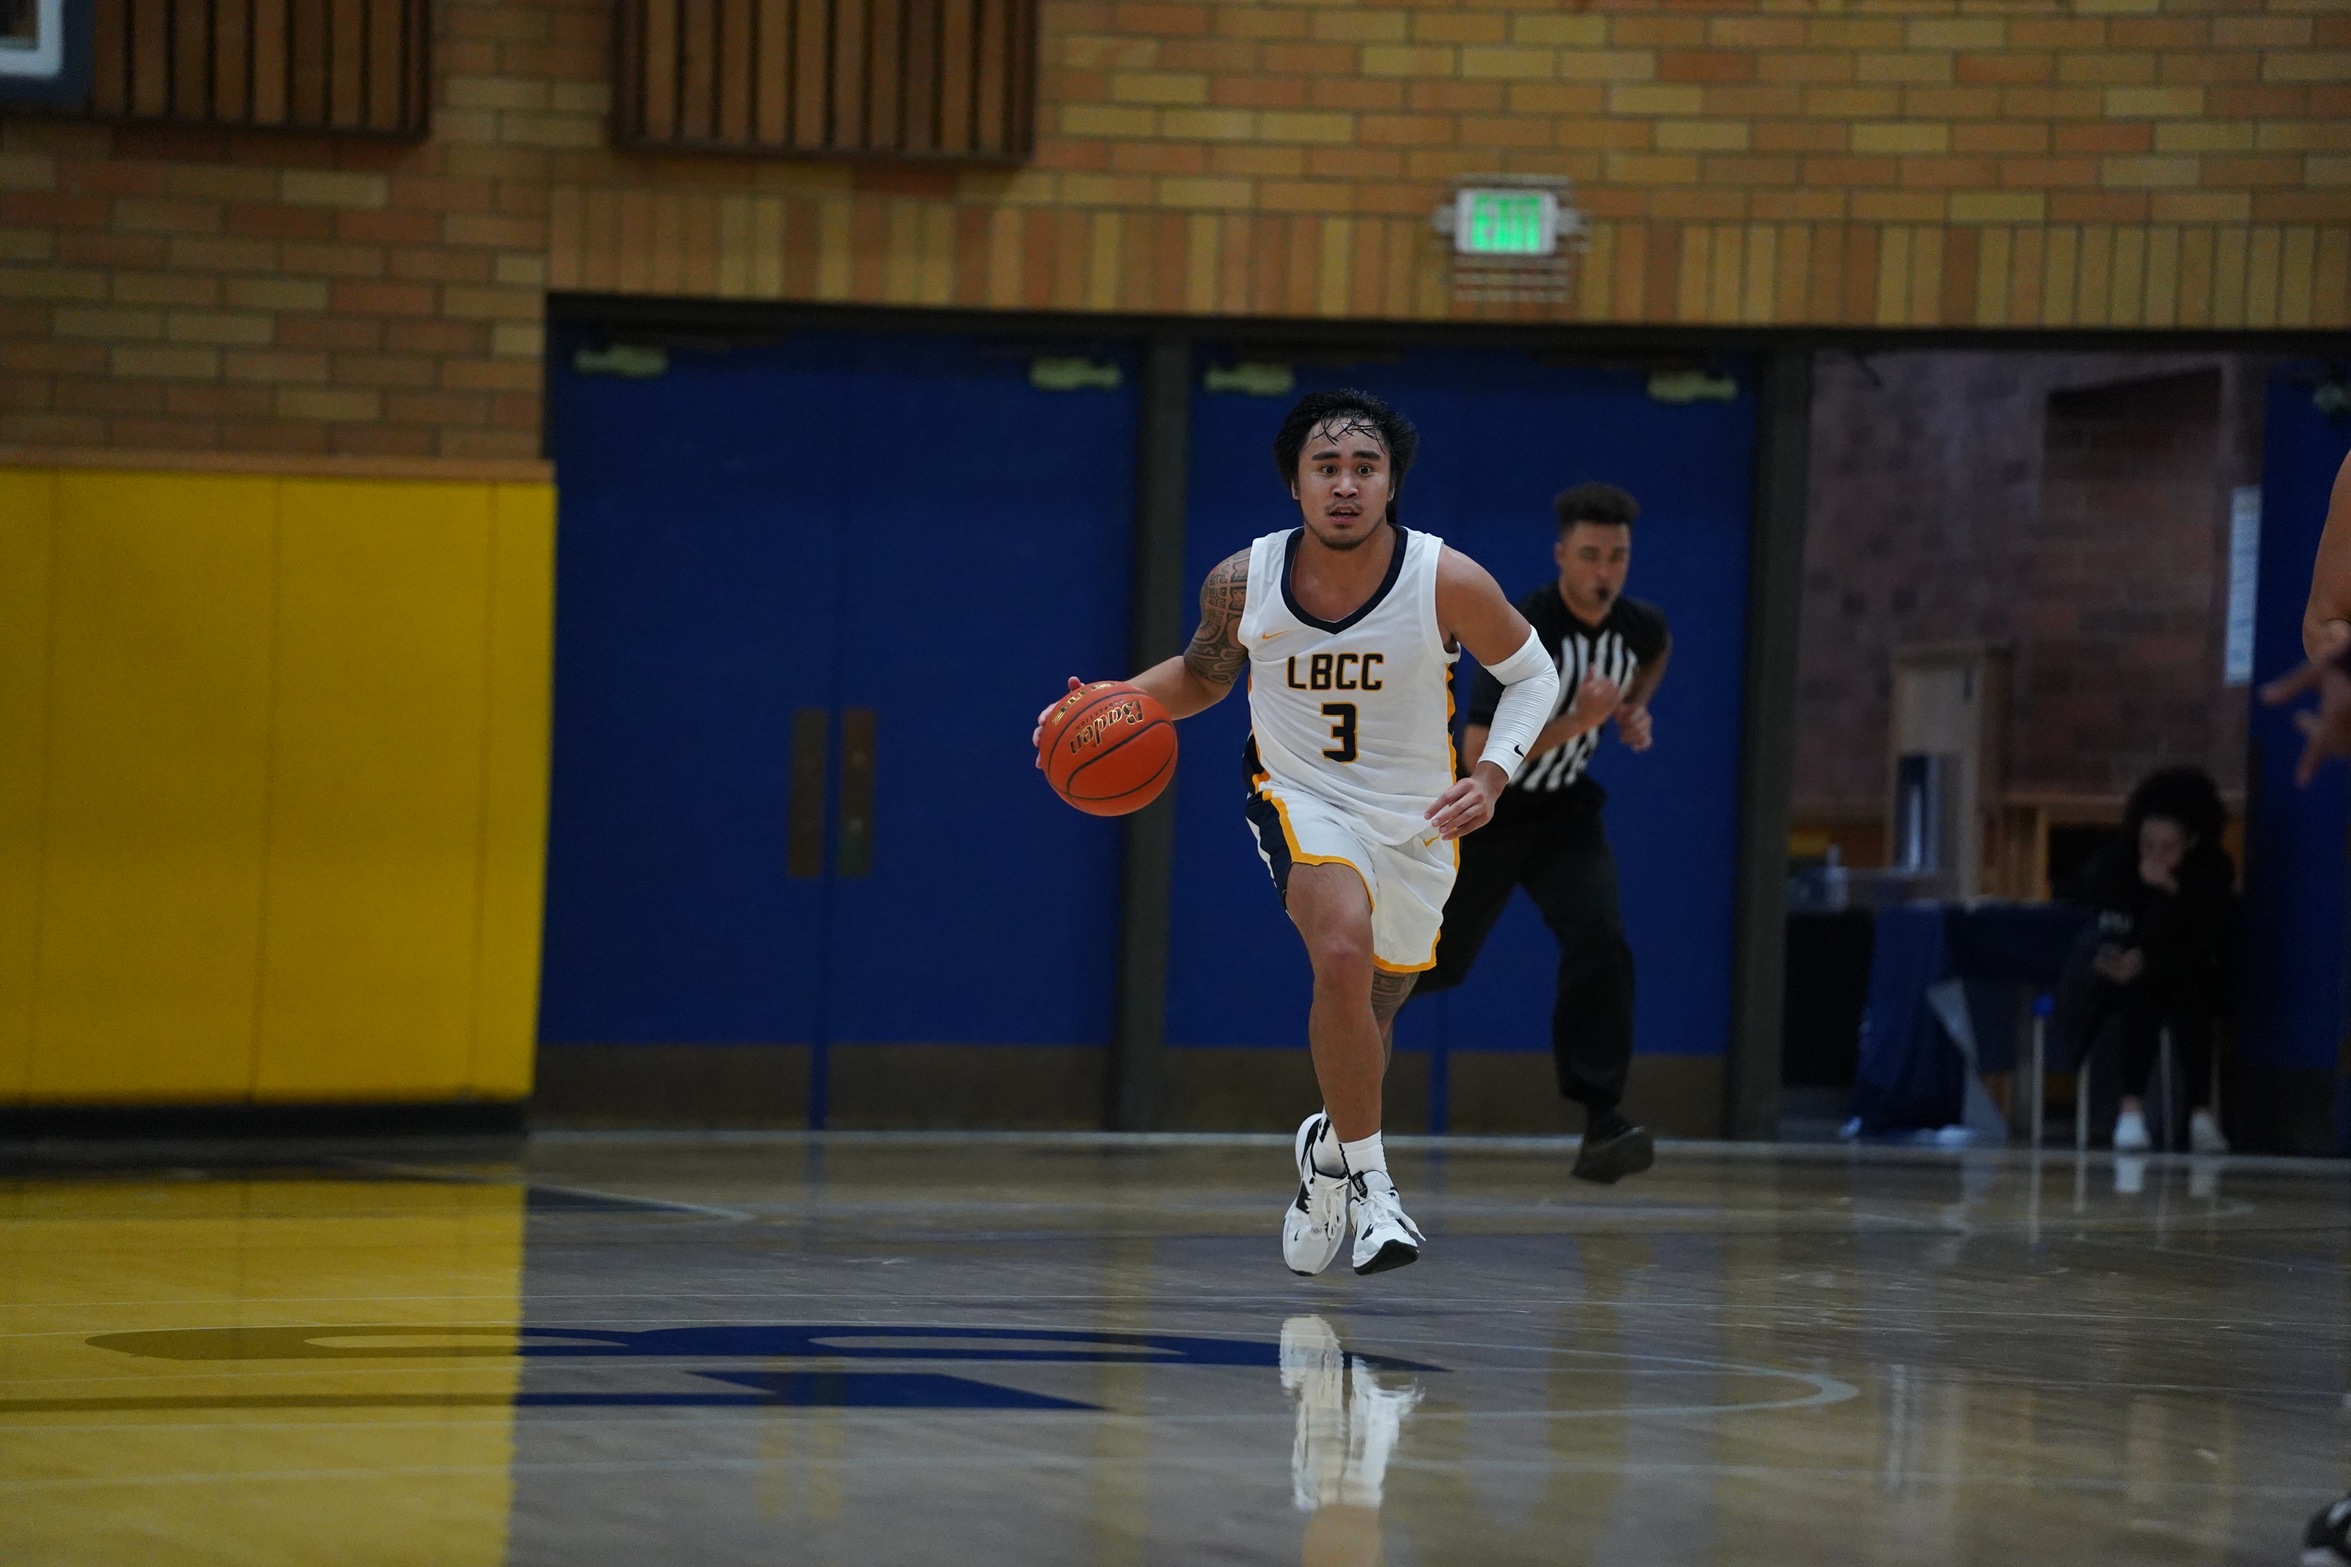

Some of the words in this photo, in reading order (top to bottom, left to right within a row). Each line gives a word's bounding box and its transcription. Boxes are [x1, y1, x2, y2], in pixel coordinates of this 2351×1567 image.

[1286, 652, 1384, 691] LBCC
[1069, 700, 1144, 754] Baden
[1320, 702, 1359, 764] 3
